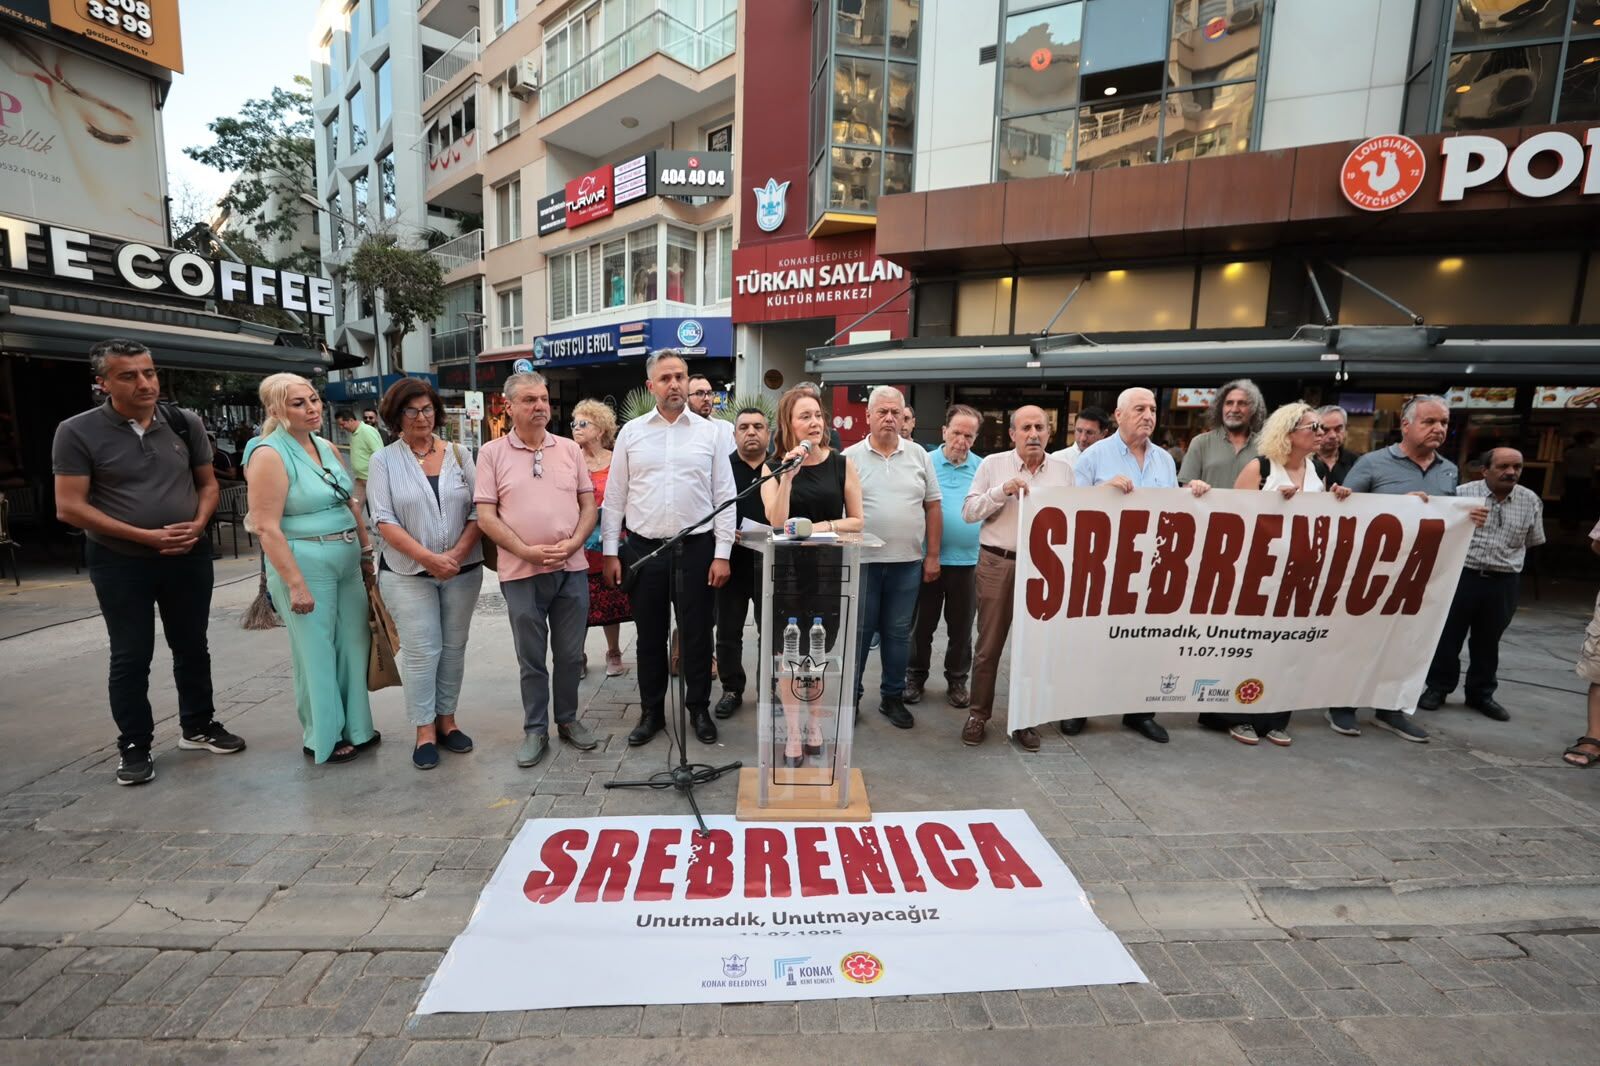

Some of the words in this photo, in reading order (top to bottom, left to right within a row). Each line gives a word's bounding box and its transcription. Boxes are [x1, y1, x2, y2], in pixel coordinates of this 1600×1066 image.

[89, 0, 119, 25] 33
[122, 14, 152, 38] 99
[1354, 138, 1416, 161] LOUISIANA
[661, 169, 686, 185] 404
[689, 170, 706, 185] 40
[708, 171, 725, 186] 04
[1354, 188, 1407, 206] KITCHEN
[778, 256, 808, 267] KONAK
[117, 243, 334, 316] COFFEE
[736, 264, 814, 295] TÜRKAN
[819, 259, 903, 287] SAYLAN
[767, 293, 813, 307] KÜLTÜR
[816, 285, 872, 302] MERKEZİ
[587, 333, 614, 352] EROL
[1026, 506, 1446, 621] SREBRENICA
[1109, 624, 1201, 640] Unutmadık,
[1206, 625, 1329, 642] Unutmayacağız
[1178, 646, 1253, 658] 11.07.1995
[1208, 688, 1230, 697] KONAK
[523, 821, 1044, 905] SREBRENICA
[636, 911, 766, 928] Unutmadık,
[772, 906, 940, 925] Unutmayacağız
[800, 966, 833, 978] KONAK
[702, 980, 727, 988] KONAK
